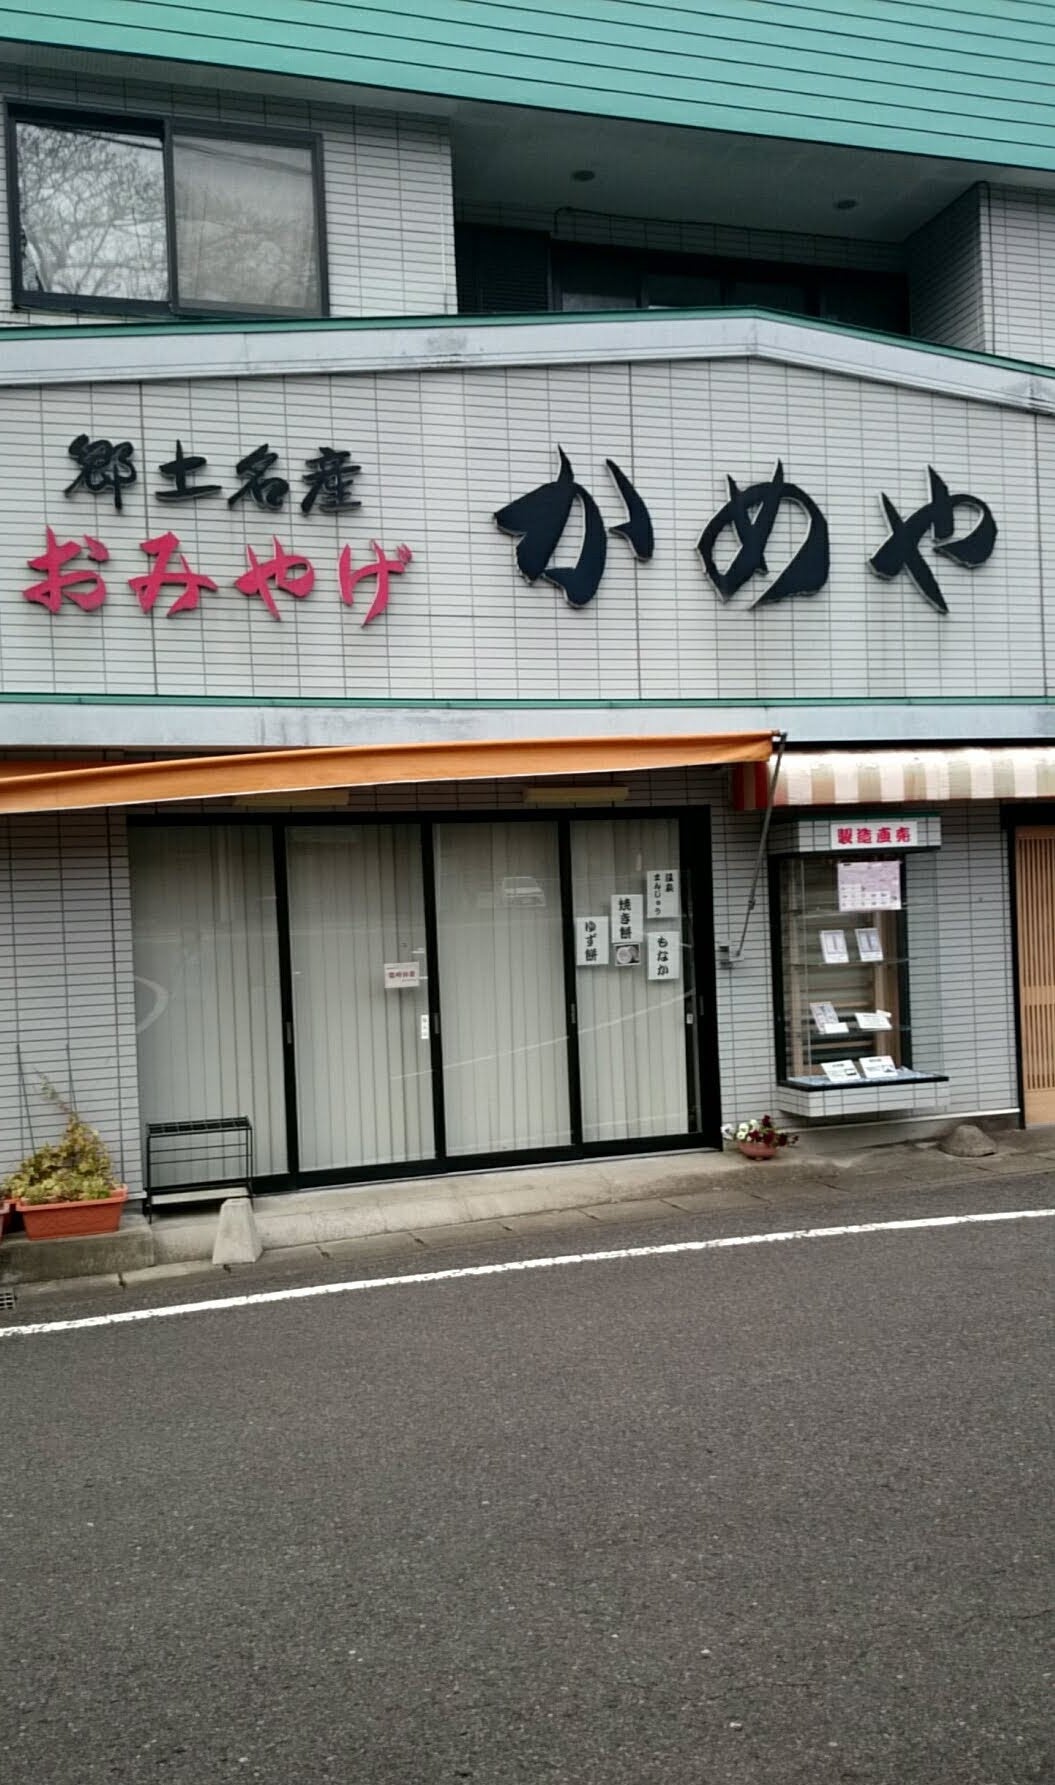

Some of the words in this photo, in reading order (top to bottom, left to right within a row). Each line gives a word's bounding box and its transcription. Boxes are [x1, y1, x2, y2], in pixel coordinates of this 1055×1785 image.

[64, 434, 363, 515] 郷土名産
[493, 445, 999, 614] かめや
[23, 525, 412, 628] おみやげ
[837, 827, 911, 845] 製造直売
[665, 872, 674, 893] 温泉
[619, 898, 631, 939] 焼き餅
[585, 921, 597, 961] ゆず餅
[656, 936, 669, 976] もなか
